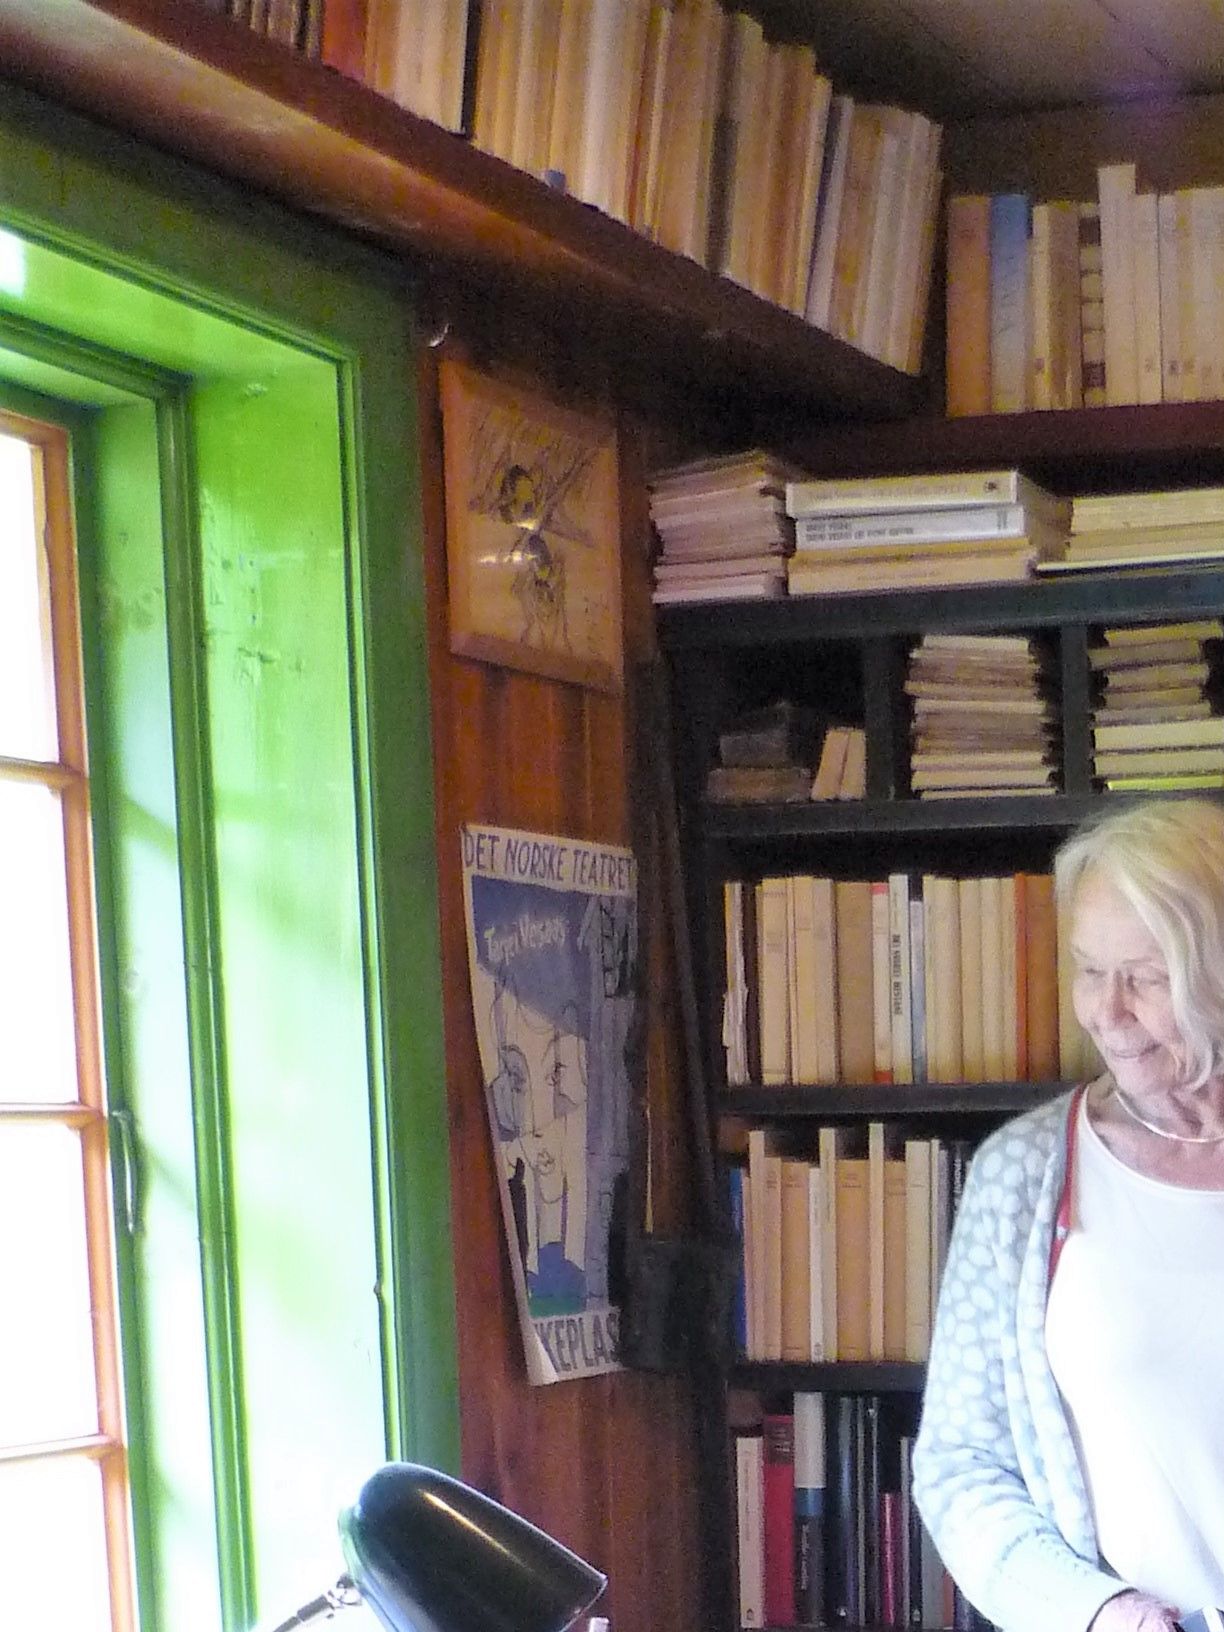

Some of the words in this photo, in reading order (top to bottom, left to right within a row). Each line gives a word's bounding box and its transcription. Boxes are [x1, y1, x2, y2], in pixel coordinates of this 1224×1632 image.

[463, 832, 500, 872] DET
[504, 838, 566, 881] NORSKE
[572, 849, 635, 890] TEATRET
